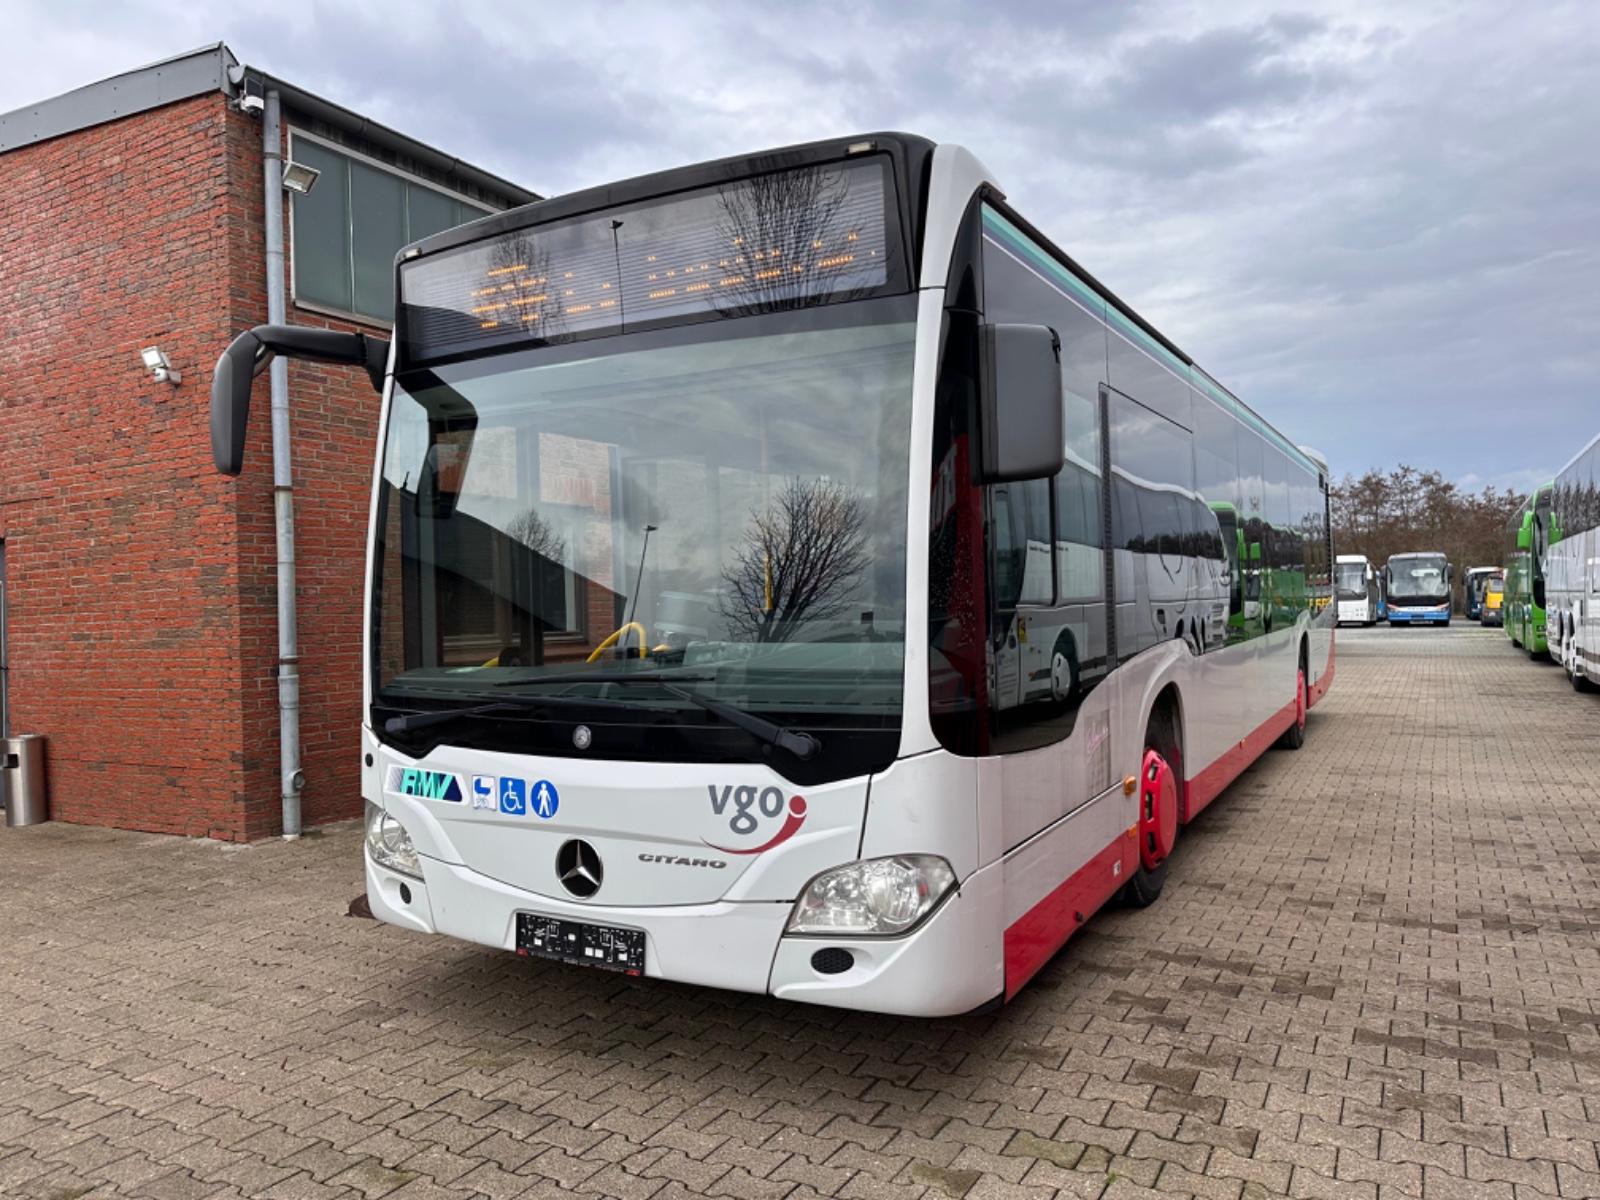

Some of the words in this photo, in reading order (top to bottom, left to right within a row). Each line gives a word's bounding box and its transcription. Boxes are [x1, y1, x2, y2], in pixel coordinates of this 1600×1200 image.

[400, 767, 452, 800] RMV
[708, 784, 784, 835] vgo
[637, 853, 727, 869] CITARO
